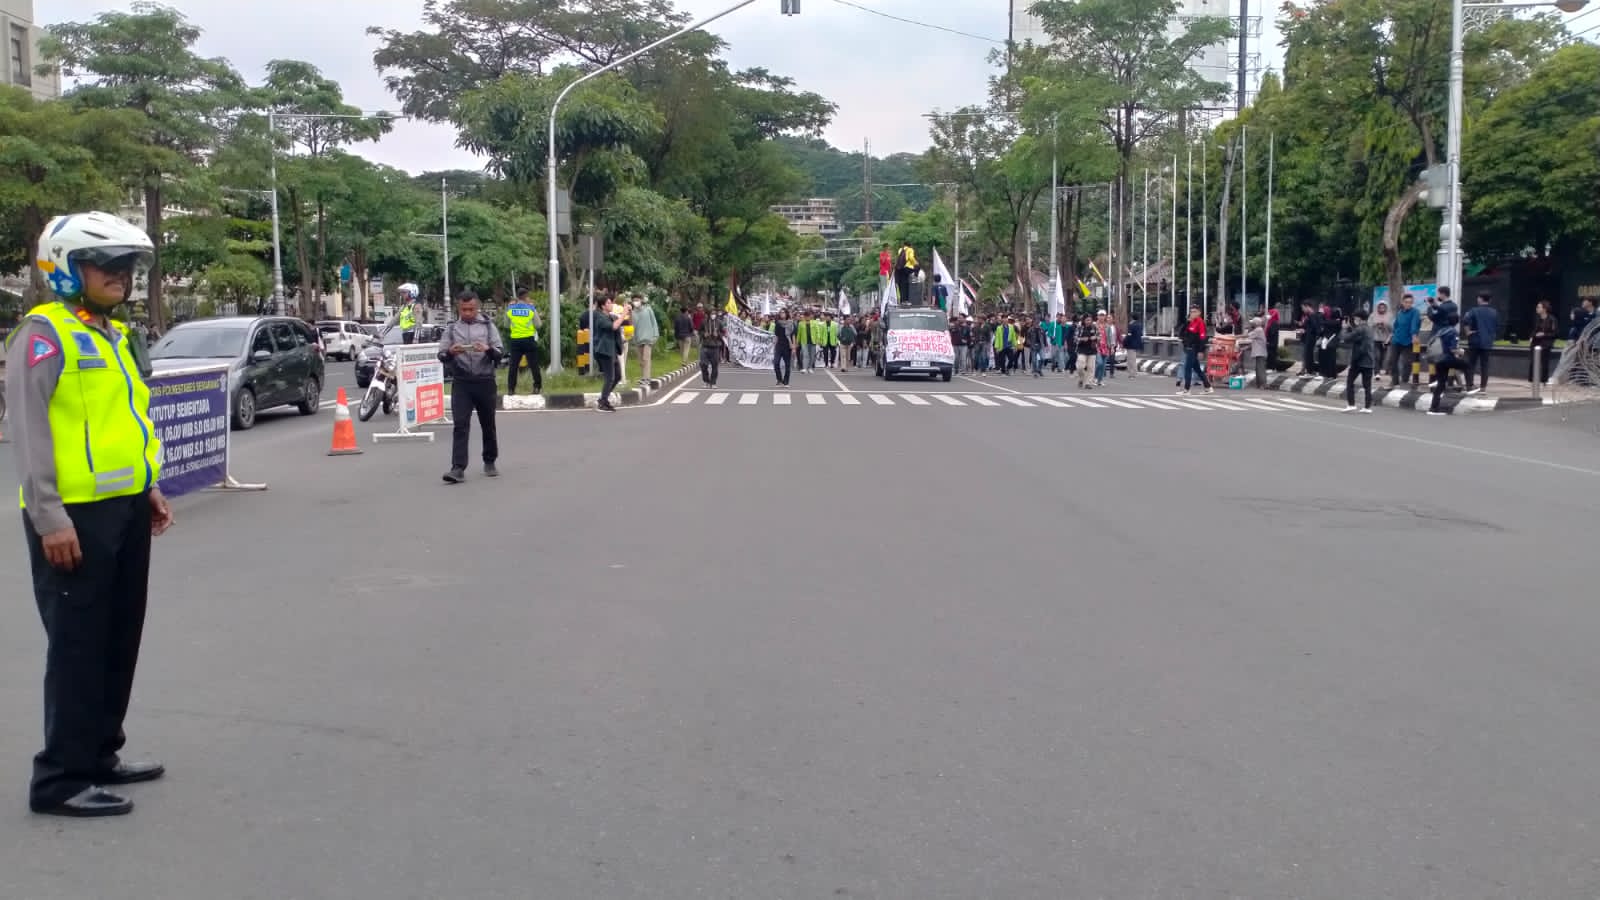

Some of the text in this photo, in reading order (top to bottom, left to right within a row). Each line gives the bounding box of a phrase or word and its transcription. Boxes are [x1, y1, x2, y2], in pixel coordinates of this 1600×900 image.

[176, 398, 210, 418] SEMENTARA
[182, 422, 194, 439] WIB
[194, 419, 203, 436] S.D
[216, 415, 225, 431] WIB
[182, 442, 194, 459] WIB
[194, 439, 204, 455] S.D
[217, 434, 226, 450] WIB
